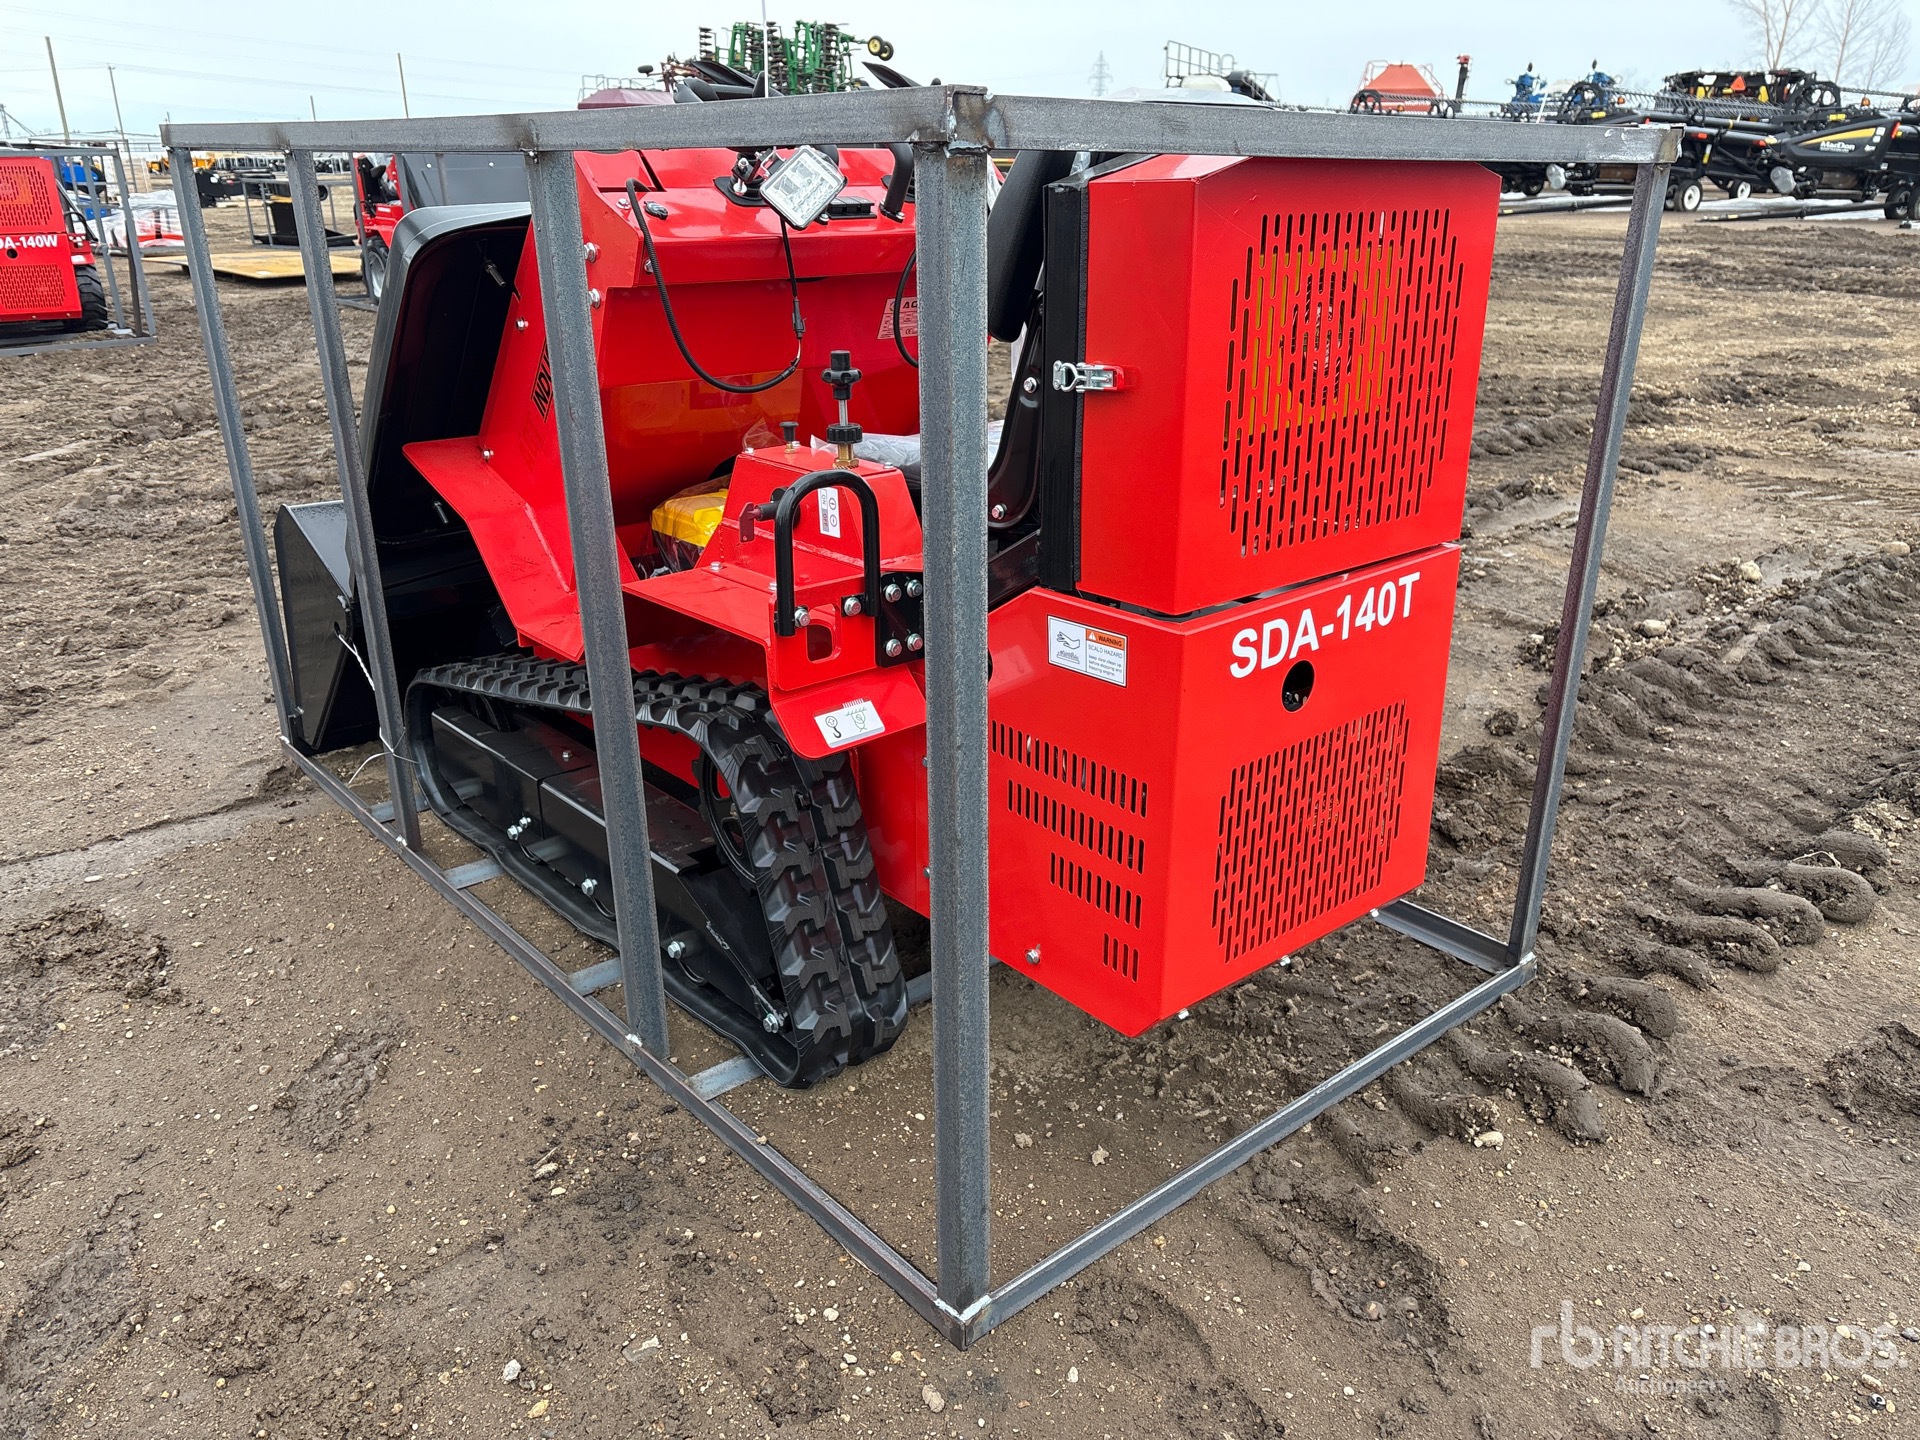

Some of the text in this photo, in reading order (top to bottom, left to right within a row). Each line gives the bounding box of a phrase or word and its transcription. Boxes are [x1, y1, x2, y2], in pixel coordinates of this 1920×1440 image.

[1820, 141, 1855, 151] MacDon
[533, 342, 553, 418] INDU
[1229, 571, 1421, 679] SDA-140T
[1098, 635, 1122, 647] WARNING
[1104, 648, 1122, 658] HAZARD
